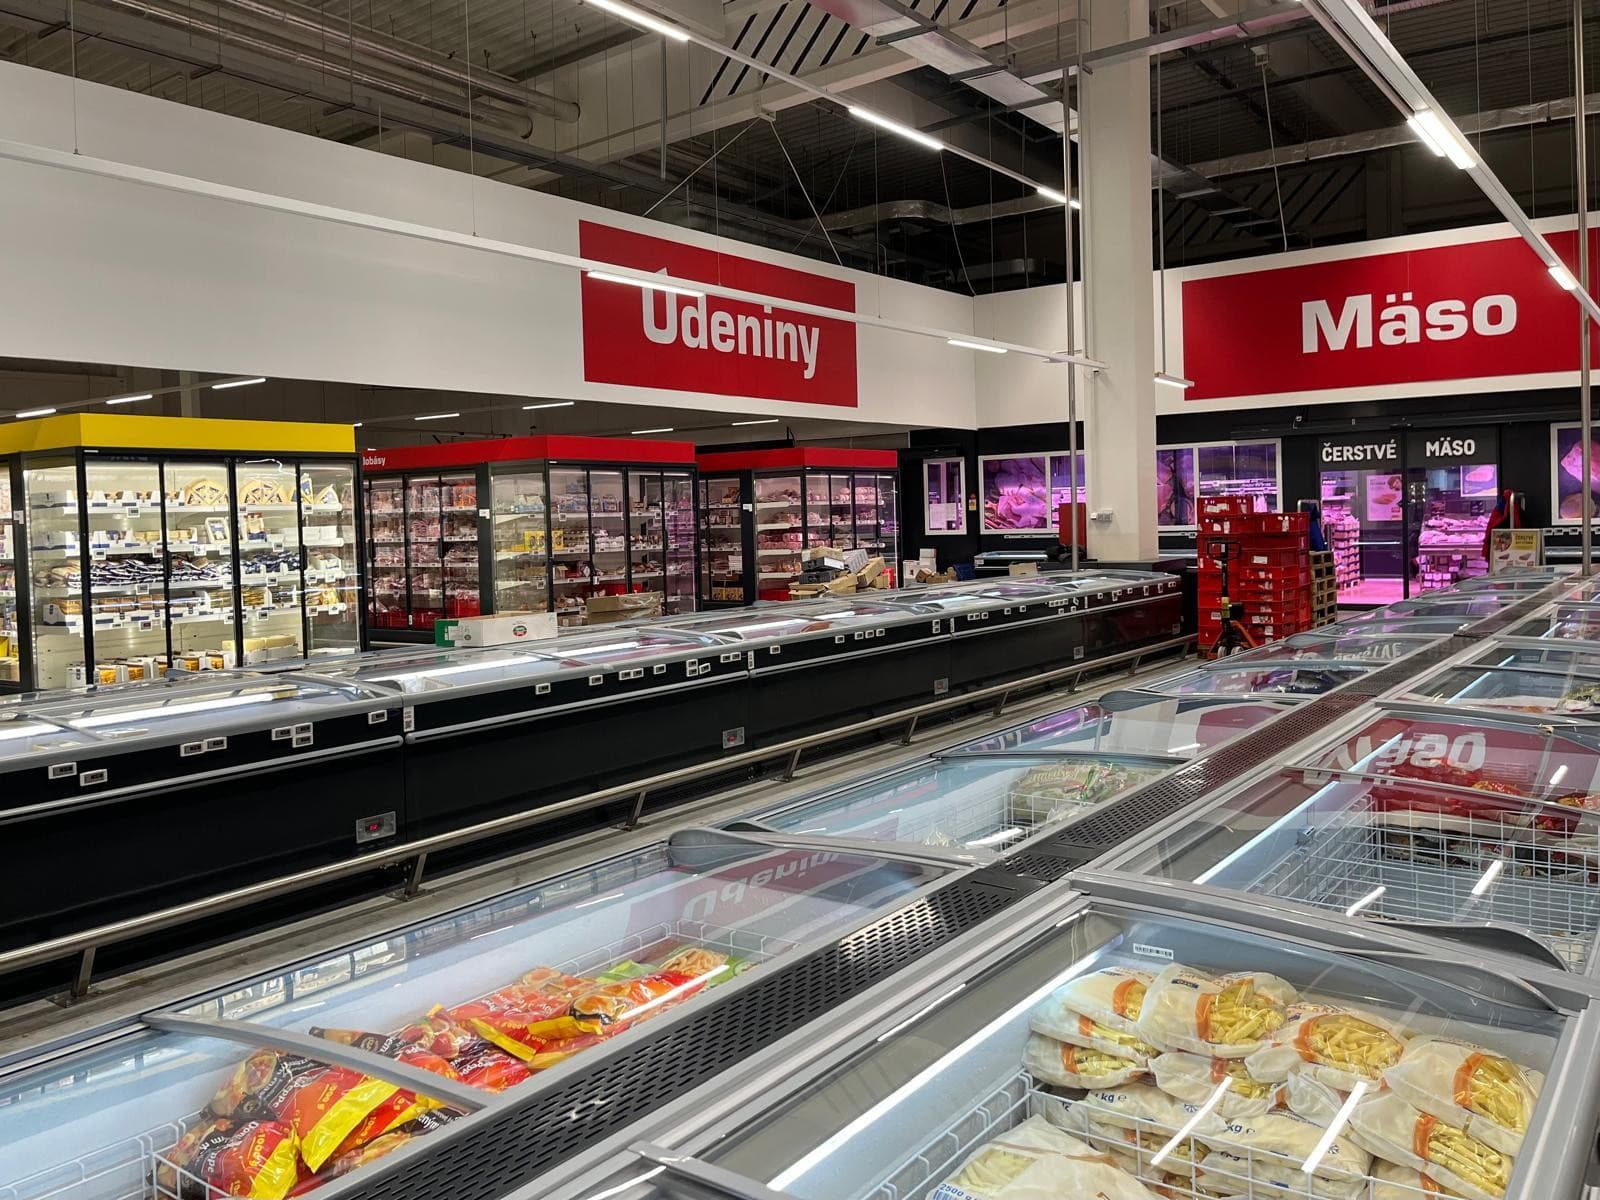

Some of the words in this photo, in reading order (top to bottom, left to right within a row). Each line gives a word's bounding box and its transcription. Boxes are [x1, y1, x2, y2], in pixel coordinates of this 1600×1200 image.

[642, 267, 820, 380] Údeniny
[1302, 292, 1517, 354] Mäso
[362, 456, 386, 467] lobásy
[1322, 439, 1397, 463] ČERSTVÉ
[1425, 437, 1476, 457] MÄSO
[939, 1183, 965, 1198] 2500
